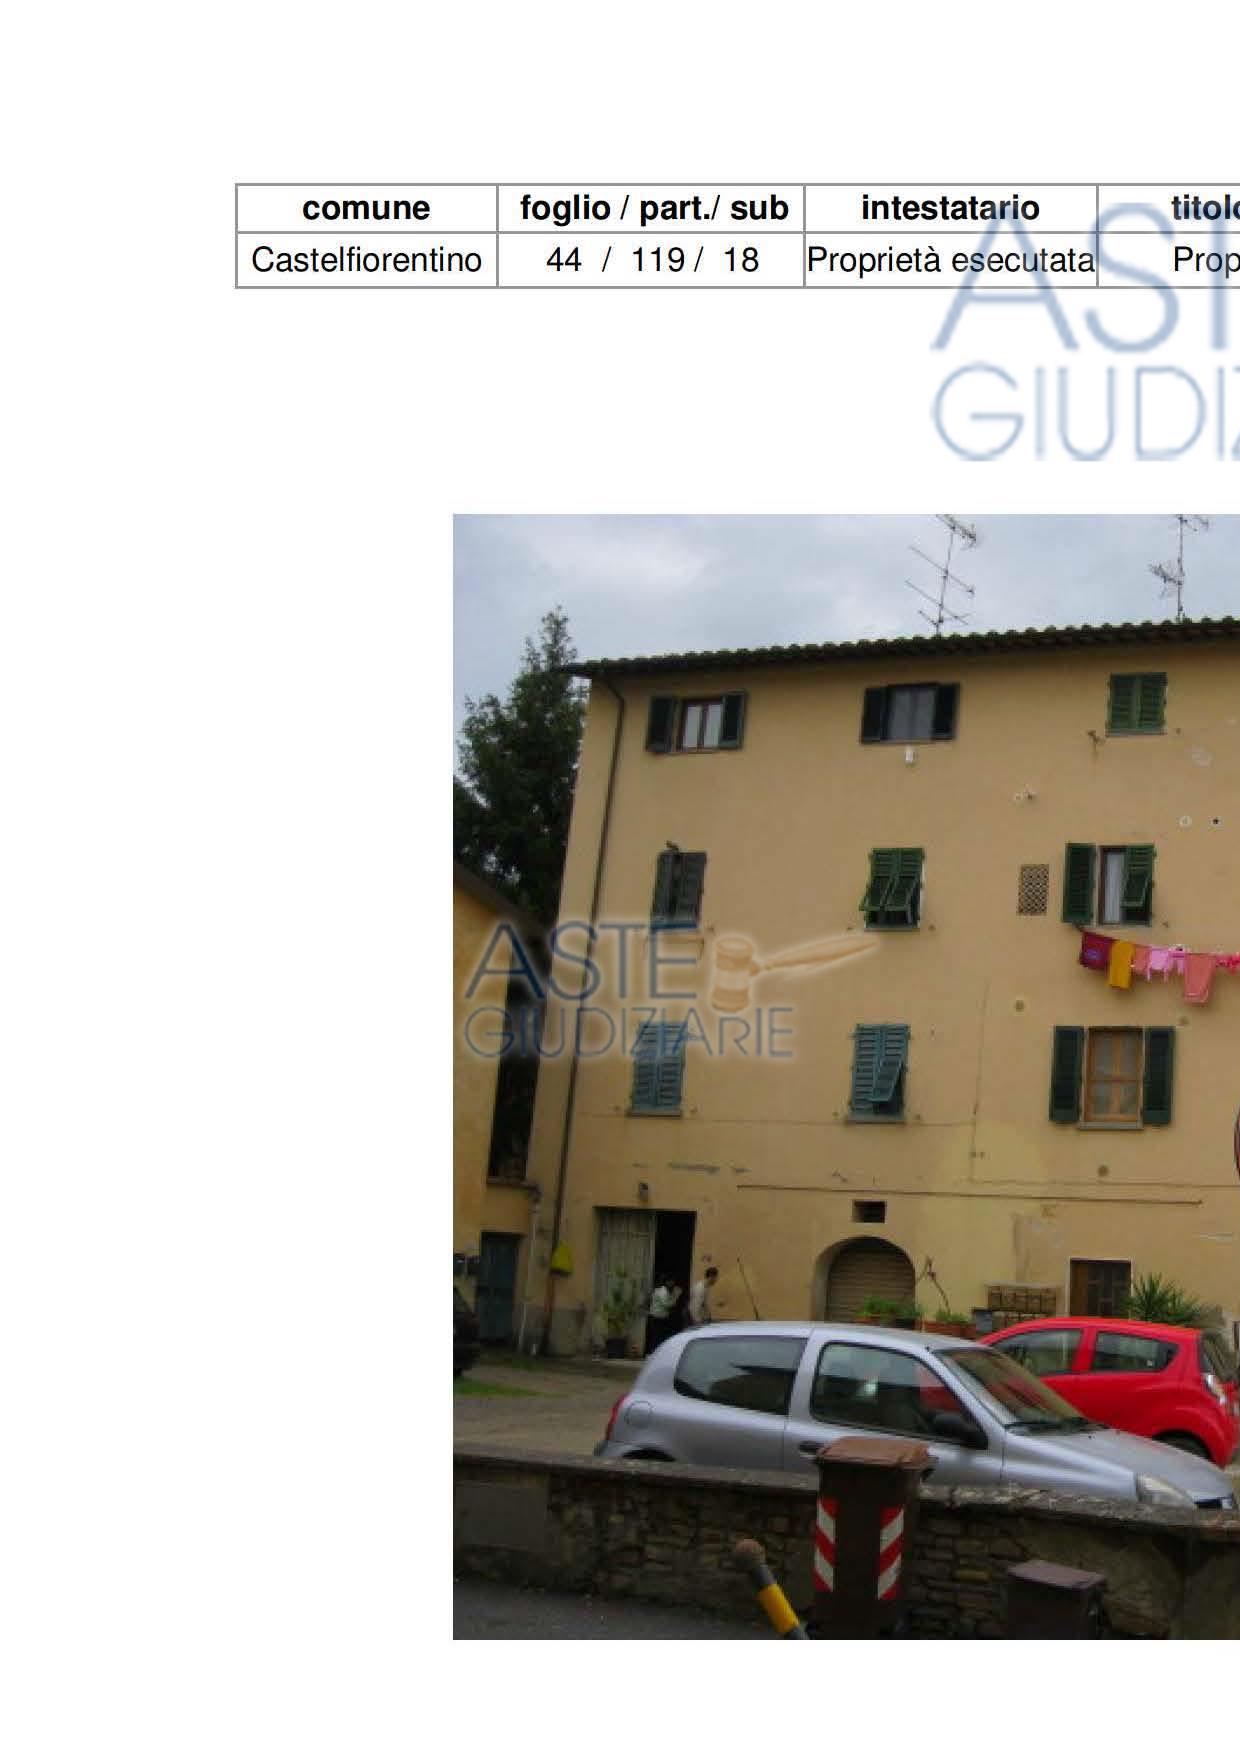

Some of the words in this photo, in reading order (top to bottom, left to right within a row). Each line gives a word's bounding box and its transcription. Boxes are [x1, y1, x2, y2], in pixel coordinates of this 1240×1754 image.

[302, 200, 430, 221] comune
[520, 194, 611, 227] foglio
[620, 194, 630, 220] /
[730, 194, 789, 221] sub
[862, 194, 1040, 221] intestatario
[252, 245, 482, 273] Castelfiorentino
[546, 246, 582, 272] 44
[601, 246, 612, 273] /
[632, 246, 685, 273] 119
[724, 246, 759, 273] 18
[808, 245, 942, 279] Proprietà
[951, 248, 1096, 273] esecutata
